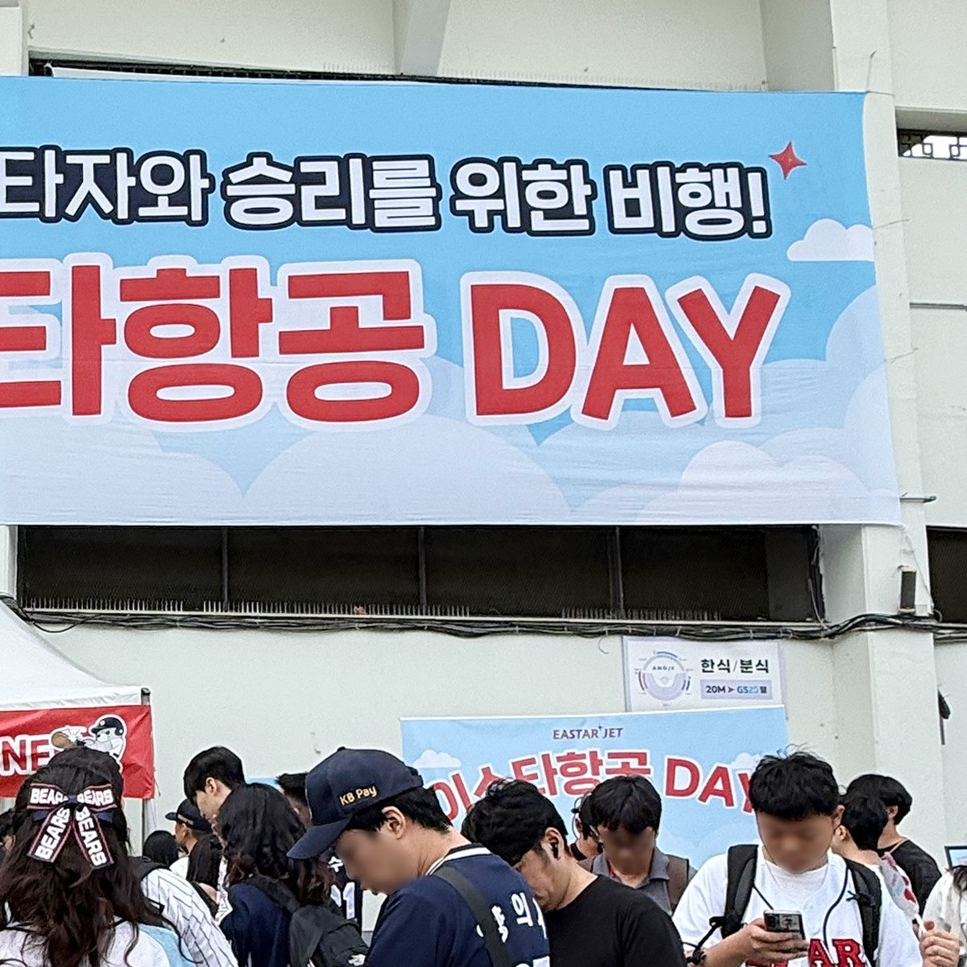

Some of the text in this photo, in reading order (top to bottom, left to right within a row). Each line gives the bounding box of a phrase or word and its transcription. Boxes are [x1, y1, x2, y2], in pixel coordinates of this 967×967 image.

[224, 152, 442, 233] 승리를
[450, 156, 596, 237] 위한
[605, 160, 773, 241] 비행!
[469, 282, 783, 421] DAY
[700, 658, 770, 674] 한식/분식
[553, 726, 624, 741] EASTAR JET
[339, 785, 377, 806] KB Pay
[34, 807, 71, 860] BEARS
